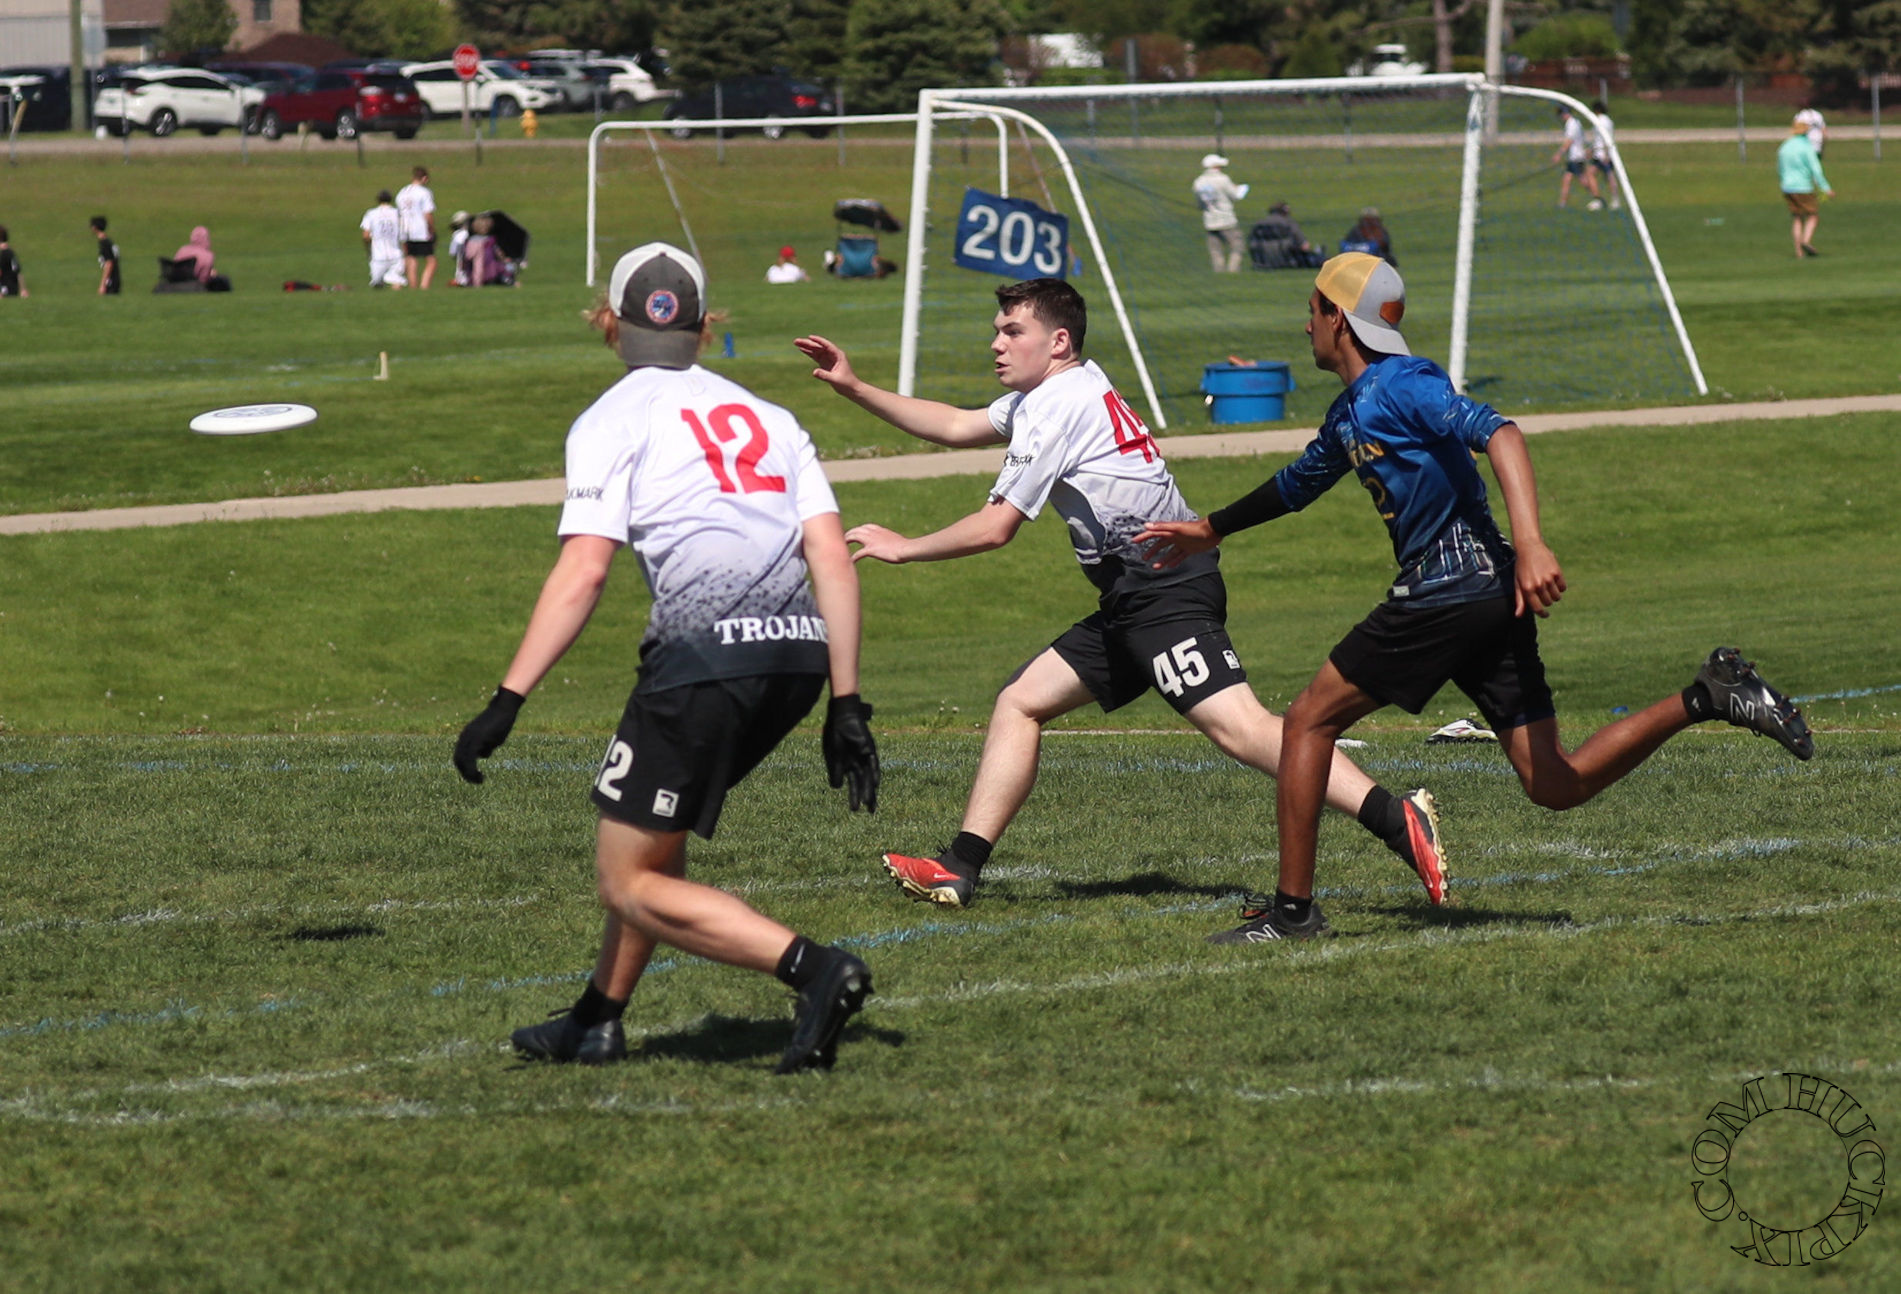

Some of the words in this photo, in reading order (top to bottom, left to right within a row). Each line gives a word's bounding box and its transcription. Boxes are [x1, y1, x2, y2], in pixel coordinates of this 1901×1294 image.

[961, 204, 1062, 275] 203
[680, 403, 786, 494] 12
[1102, 387, 1160, 464] 4
[1152, 636, 1210, 697] 45
[594, 734, 634, 802] 2
